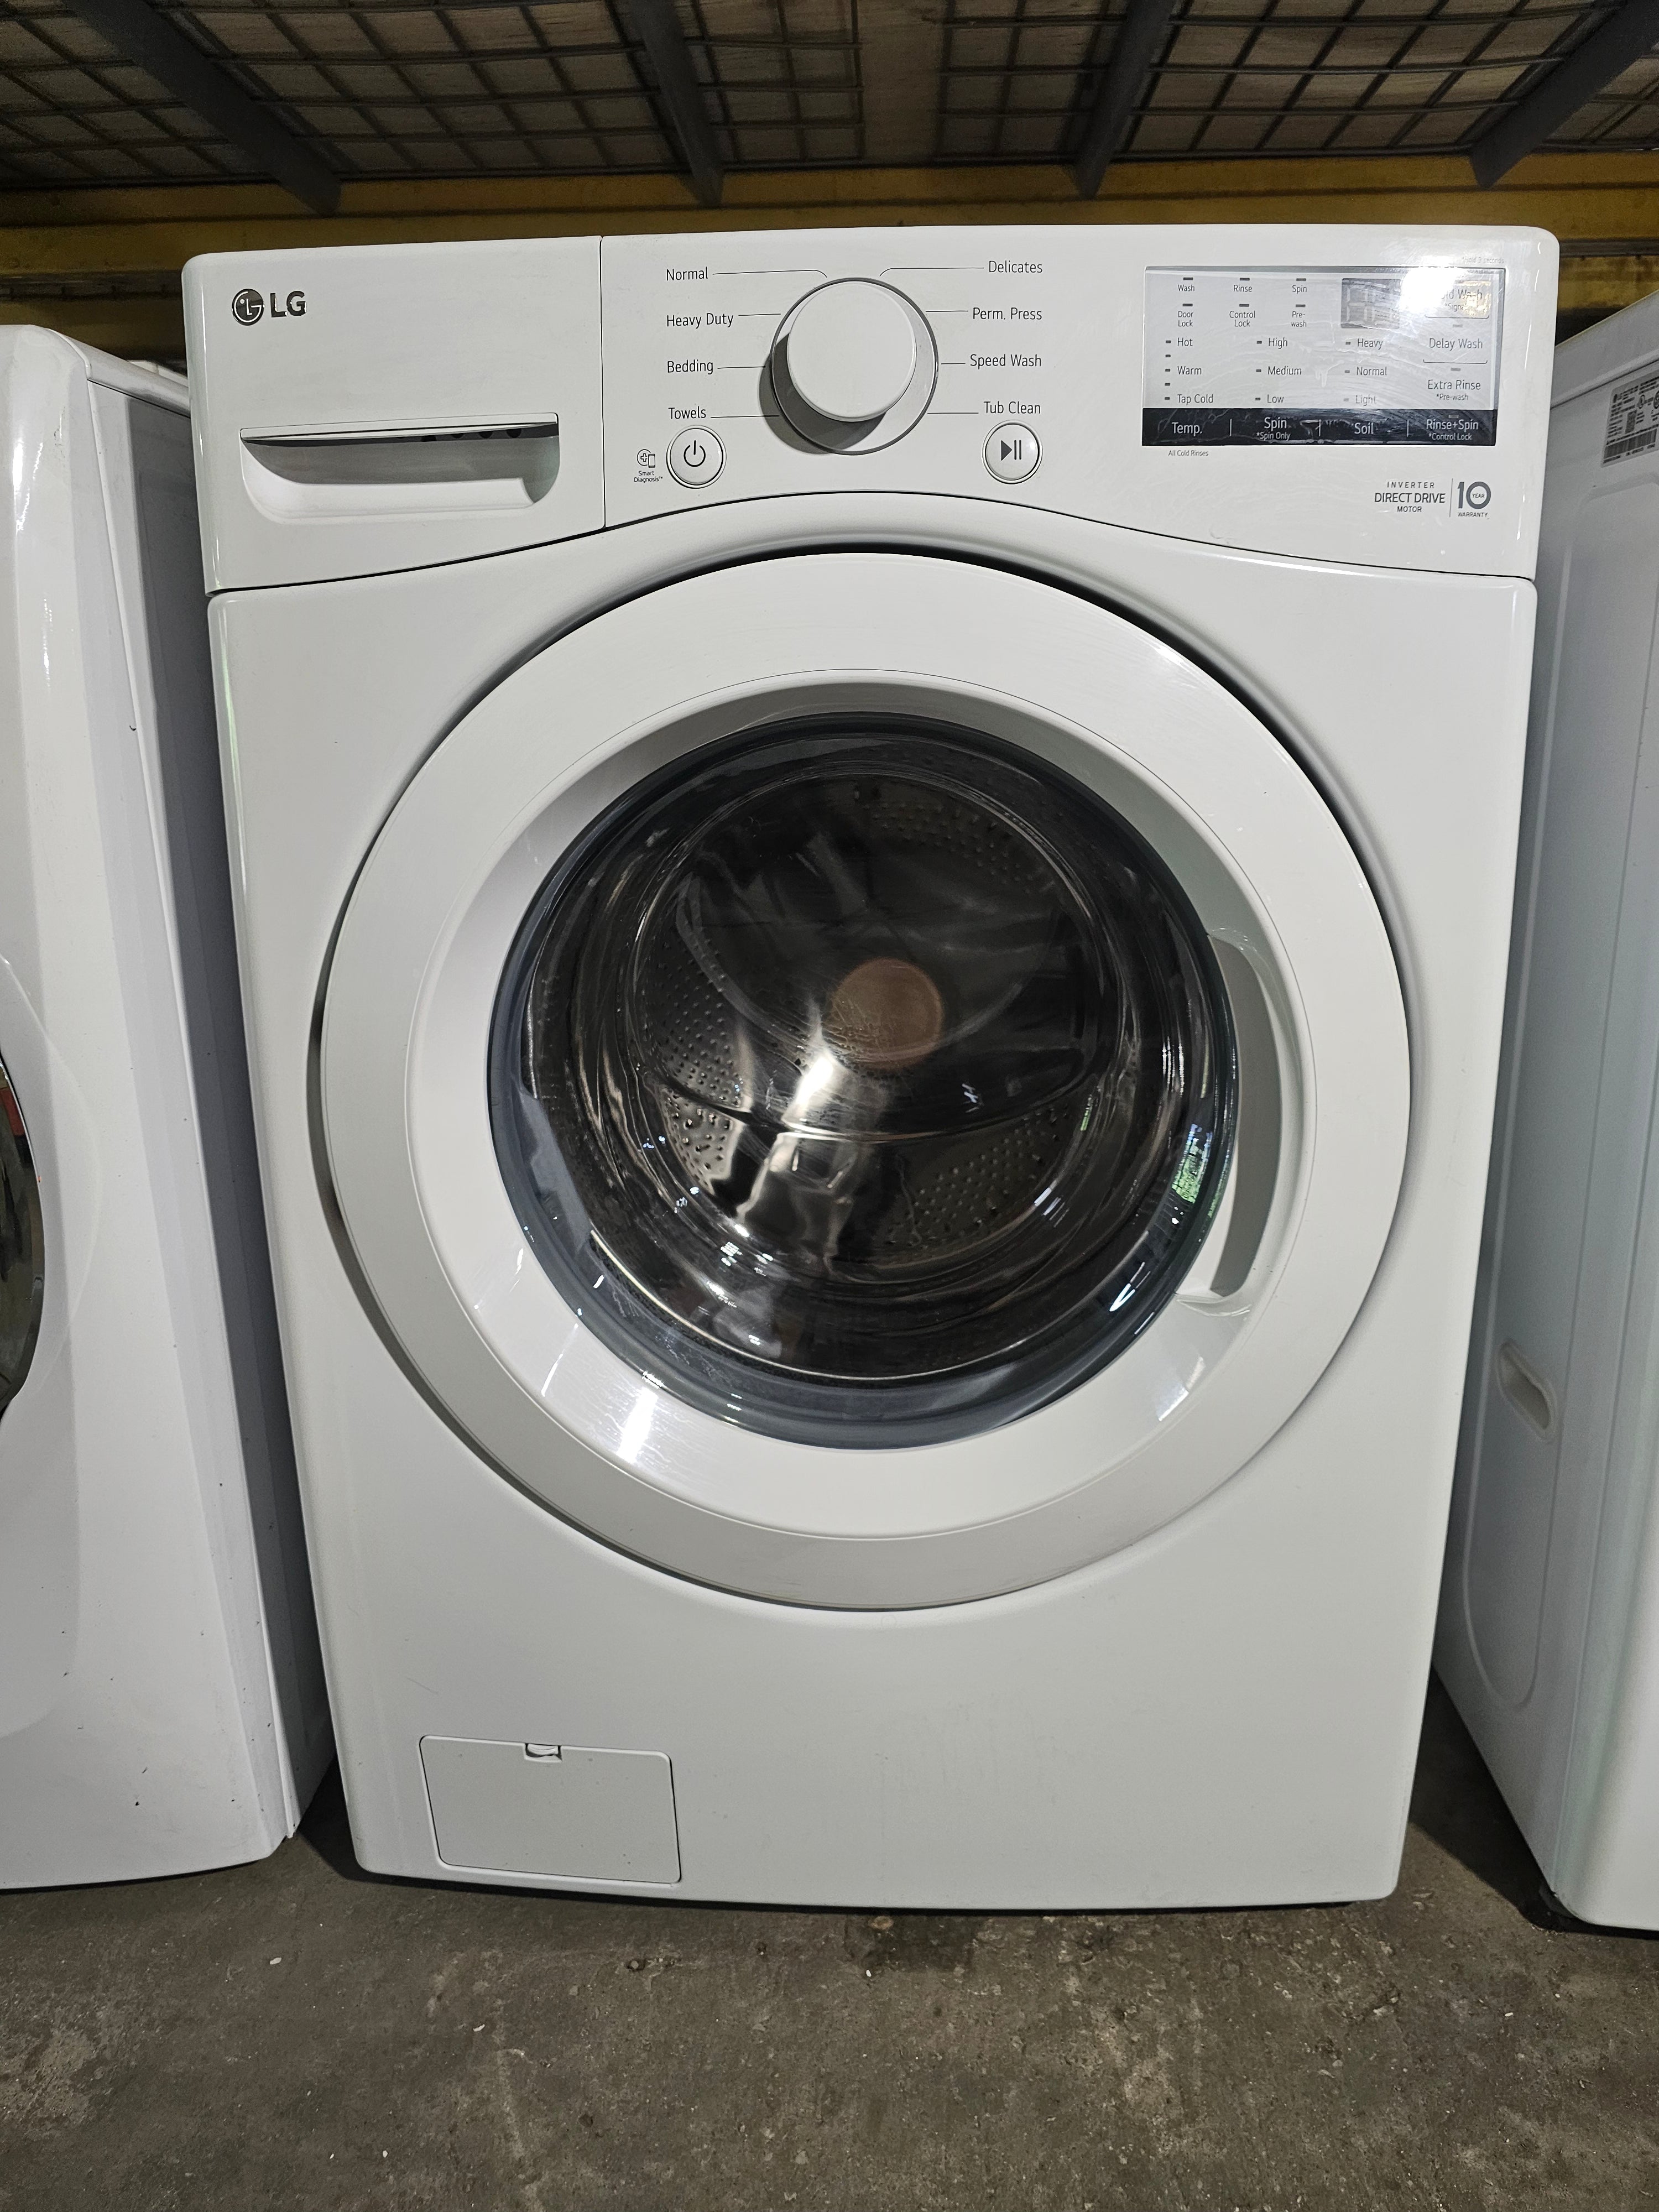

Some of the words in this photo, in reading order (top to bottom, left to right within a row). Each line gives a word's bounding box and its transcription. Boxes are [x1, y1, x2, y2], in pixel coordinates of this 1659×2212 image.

[988, 260, 1043, 273] Delicates
[666, 267, 708, 281] Normal
[1233, 284, 1253, 293] Rinse
[1292, 285, 1307, 294] Spin
[270, 290, 307, 317] LG
[667, 315, 702, 328] Heavy
[706, 313, 734, 327] Duty
[973, 307, 1006, 321] Perm.
[1010, 307, 1042, 320] Press
[1177, 338, 1193, 347] Hot
[1268, 337, 1288, 349] High
[1357, 338, 1383, 349] Heavy
[1429, 338, 1455, 352] Delay
[1458, 338, 1483, 349] Wash
[667, 360, 714, 374] Bedding
[971, 354, 1006, 370] Speed
[1010, 354, 1042, 367] Wash
[1177, 366, 1202, 375] Warm
[1268, 366, 1302, 375] Medium
[1357, 367, 1387, 375] Normal
[1428, 379, 1452, 389] Extra
[1455, 379, 1481, 390] Rinse
[1177, 394, 1191, 405] Tap
[1194, 394, 1213, 403] Cold
[1267, 395, 1284, 403] Low
[1355, 395, 1377, 406] Light
[669, 406, 706, 420] Towels
[983, 401, 1004, 414] Tub
[1009, 401, 1041, 414] Clean
[1172, 422, 1203, 435] Temp.
[1264, 417, 1287, 431] Spin
[1354, 422, 1375, 435] Soil
[1426, 419, 1479, 432] Rinse+Spin
[1275, 431, 1291, 440] Only
[1374, 493, 1412, 503] DIRECT
[1414, 493, 1446, 503] DRIVE
[1457, 481, 1491, 509] 10
